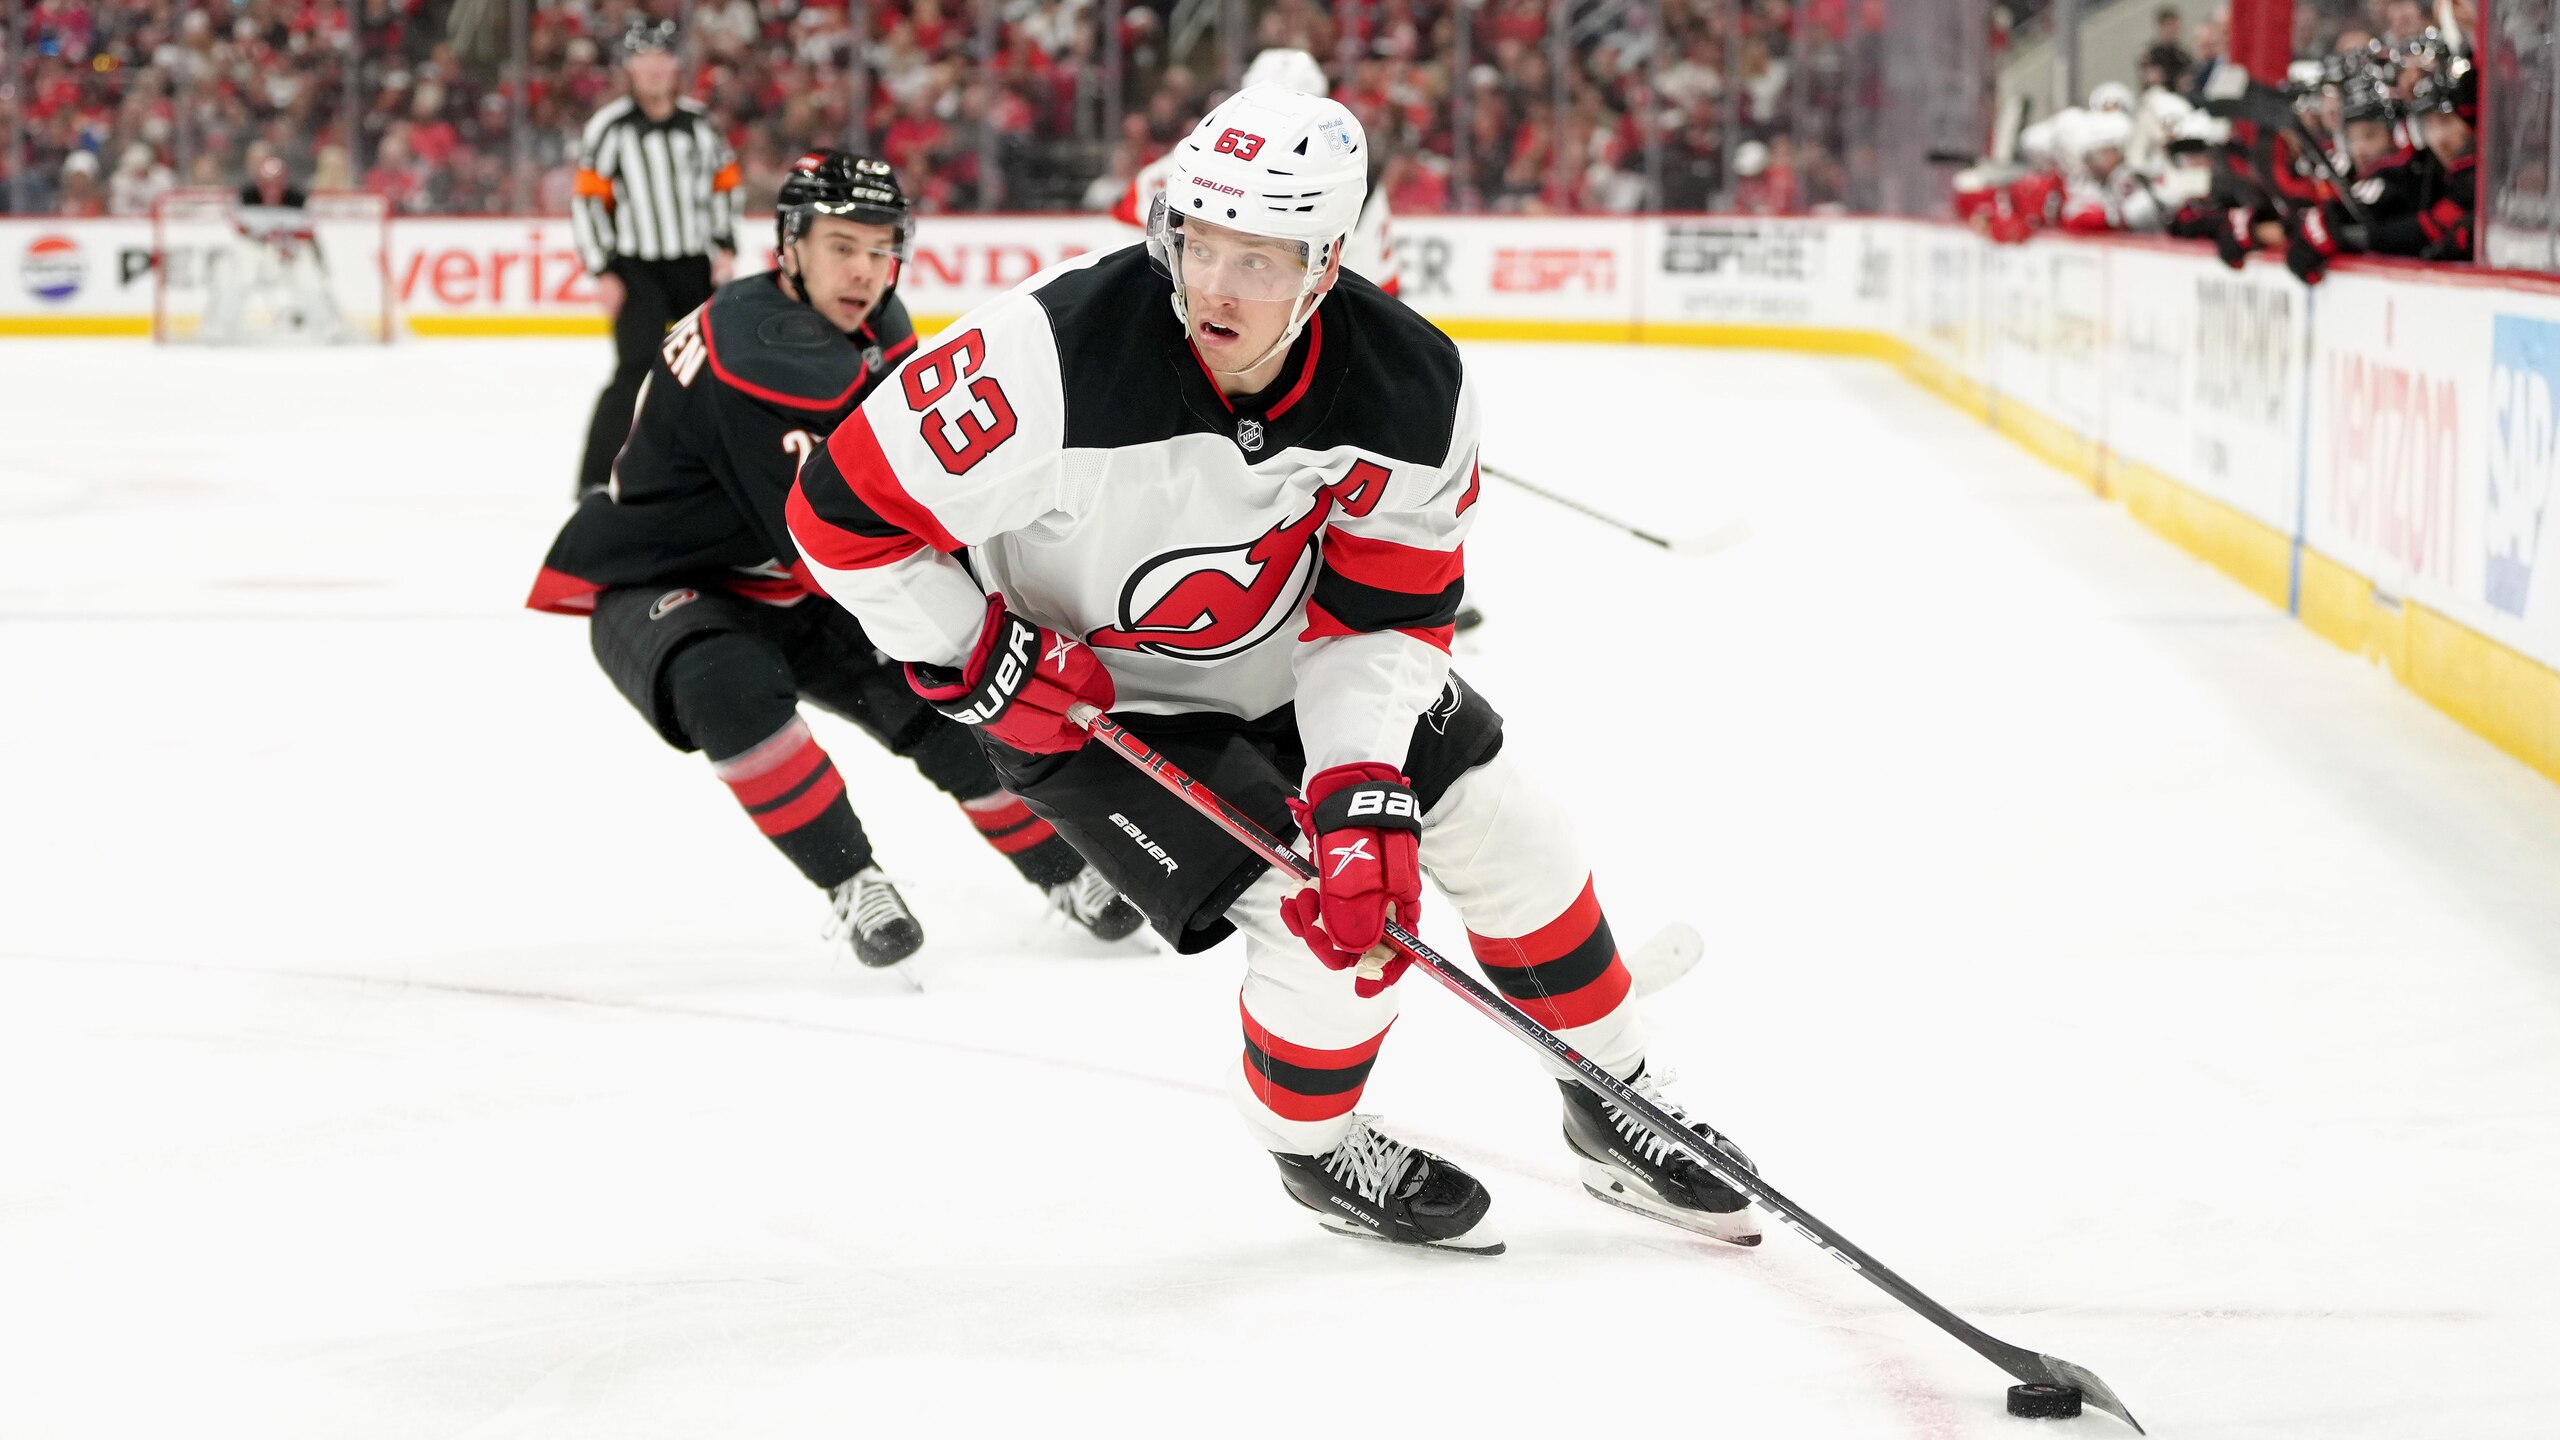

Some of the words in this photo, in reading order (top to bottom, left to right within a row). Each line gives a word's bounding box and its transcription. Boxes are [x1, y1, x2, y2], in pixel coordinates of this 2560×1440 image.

[1213, 127, 1266, 162] 63
[1191, 176, 1245, 199] BAUER
[389, 231, 602, 304] veriz
[899, 327, 1019, 476] 63
[936, 619, 1035, 726] AUER
[1108, 811, 1179, 878] BAUER
[1274, 843, 1298, 864] BRATT
[1607, 1146, 1656, 1184] BAUER
[1330, 1195, 1381, 1229] BAUER
